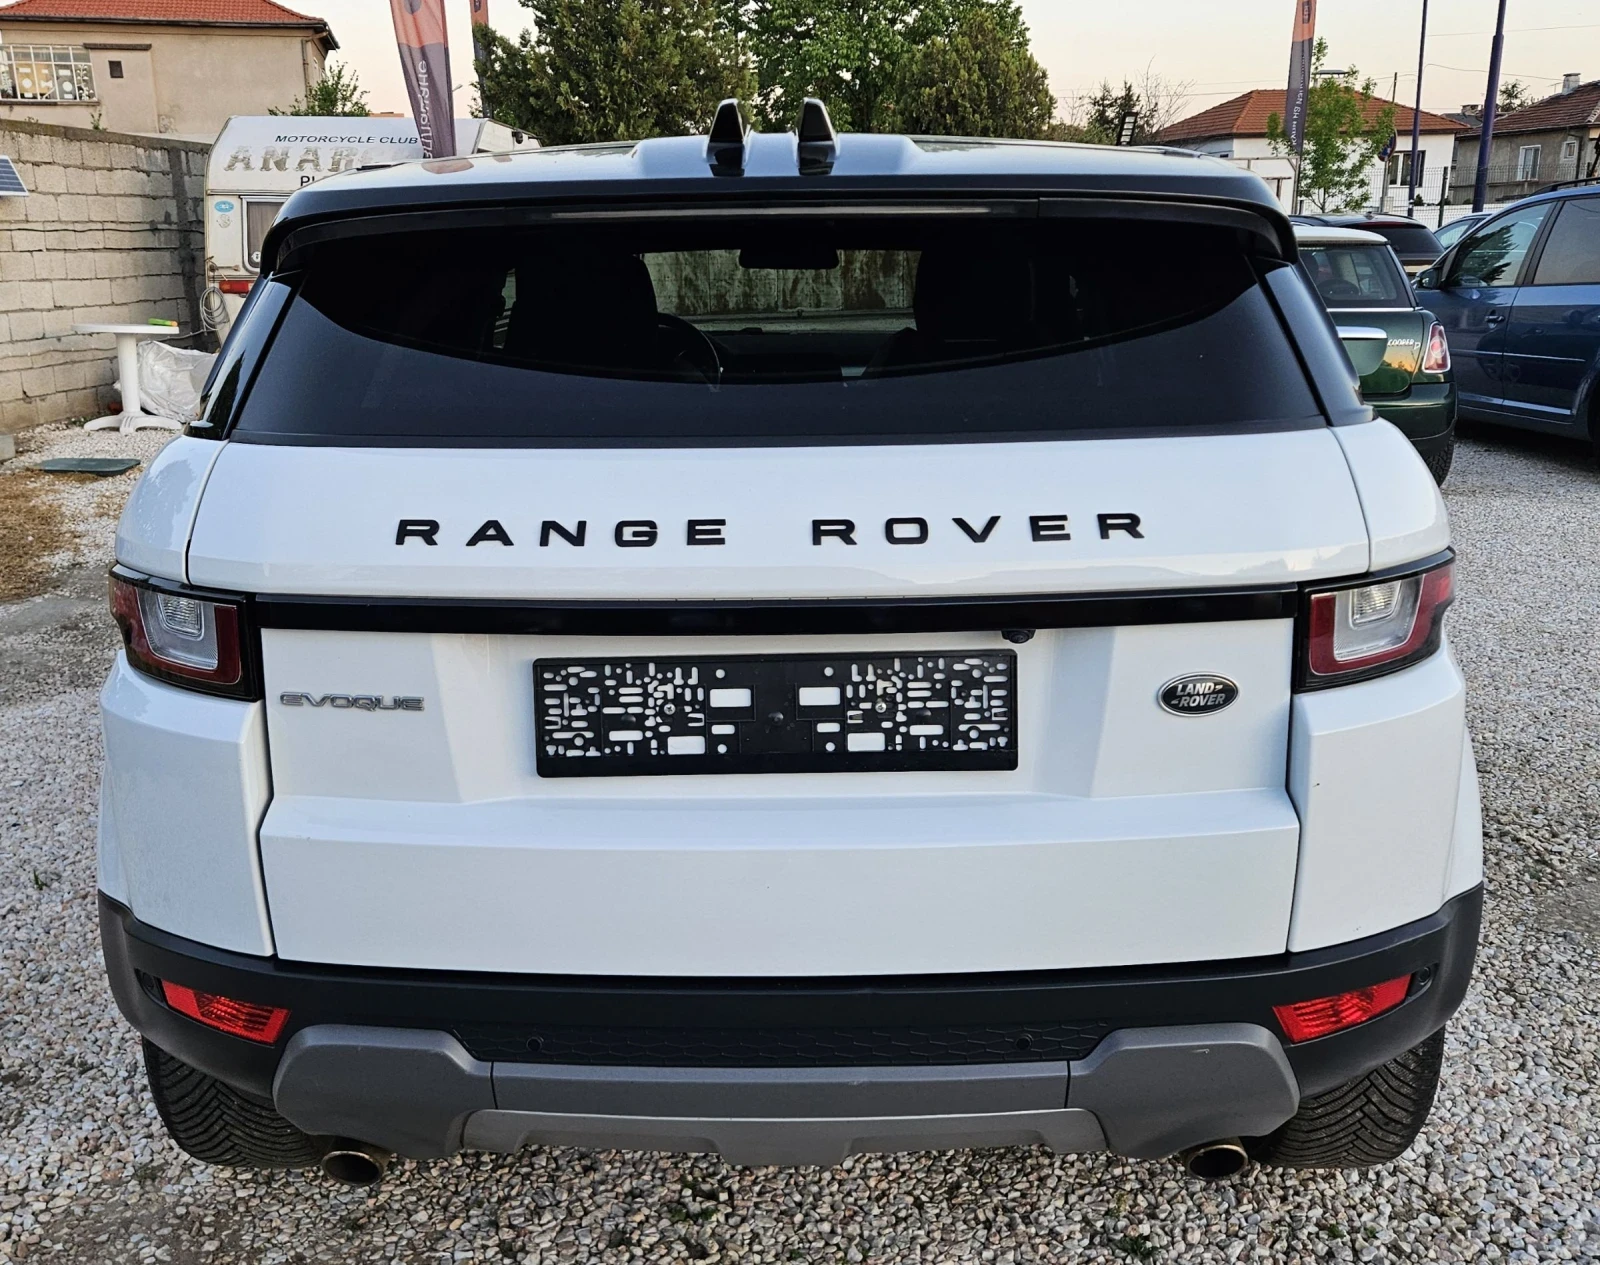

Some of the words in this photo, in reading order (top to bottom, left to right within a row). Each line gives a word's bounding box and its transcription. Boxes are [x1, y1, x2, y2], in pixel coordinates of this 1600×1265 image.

[275, 135, 377, 144] MOTORCYCLE
[379, 136, 419, 144] CLUB
[395, 518, 727, 547] RANGE
[812, 512, 1146, 546] ROVER
[280, 691, 425, 712] EVOQUE
